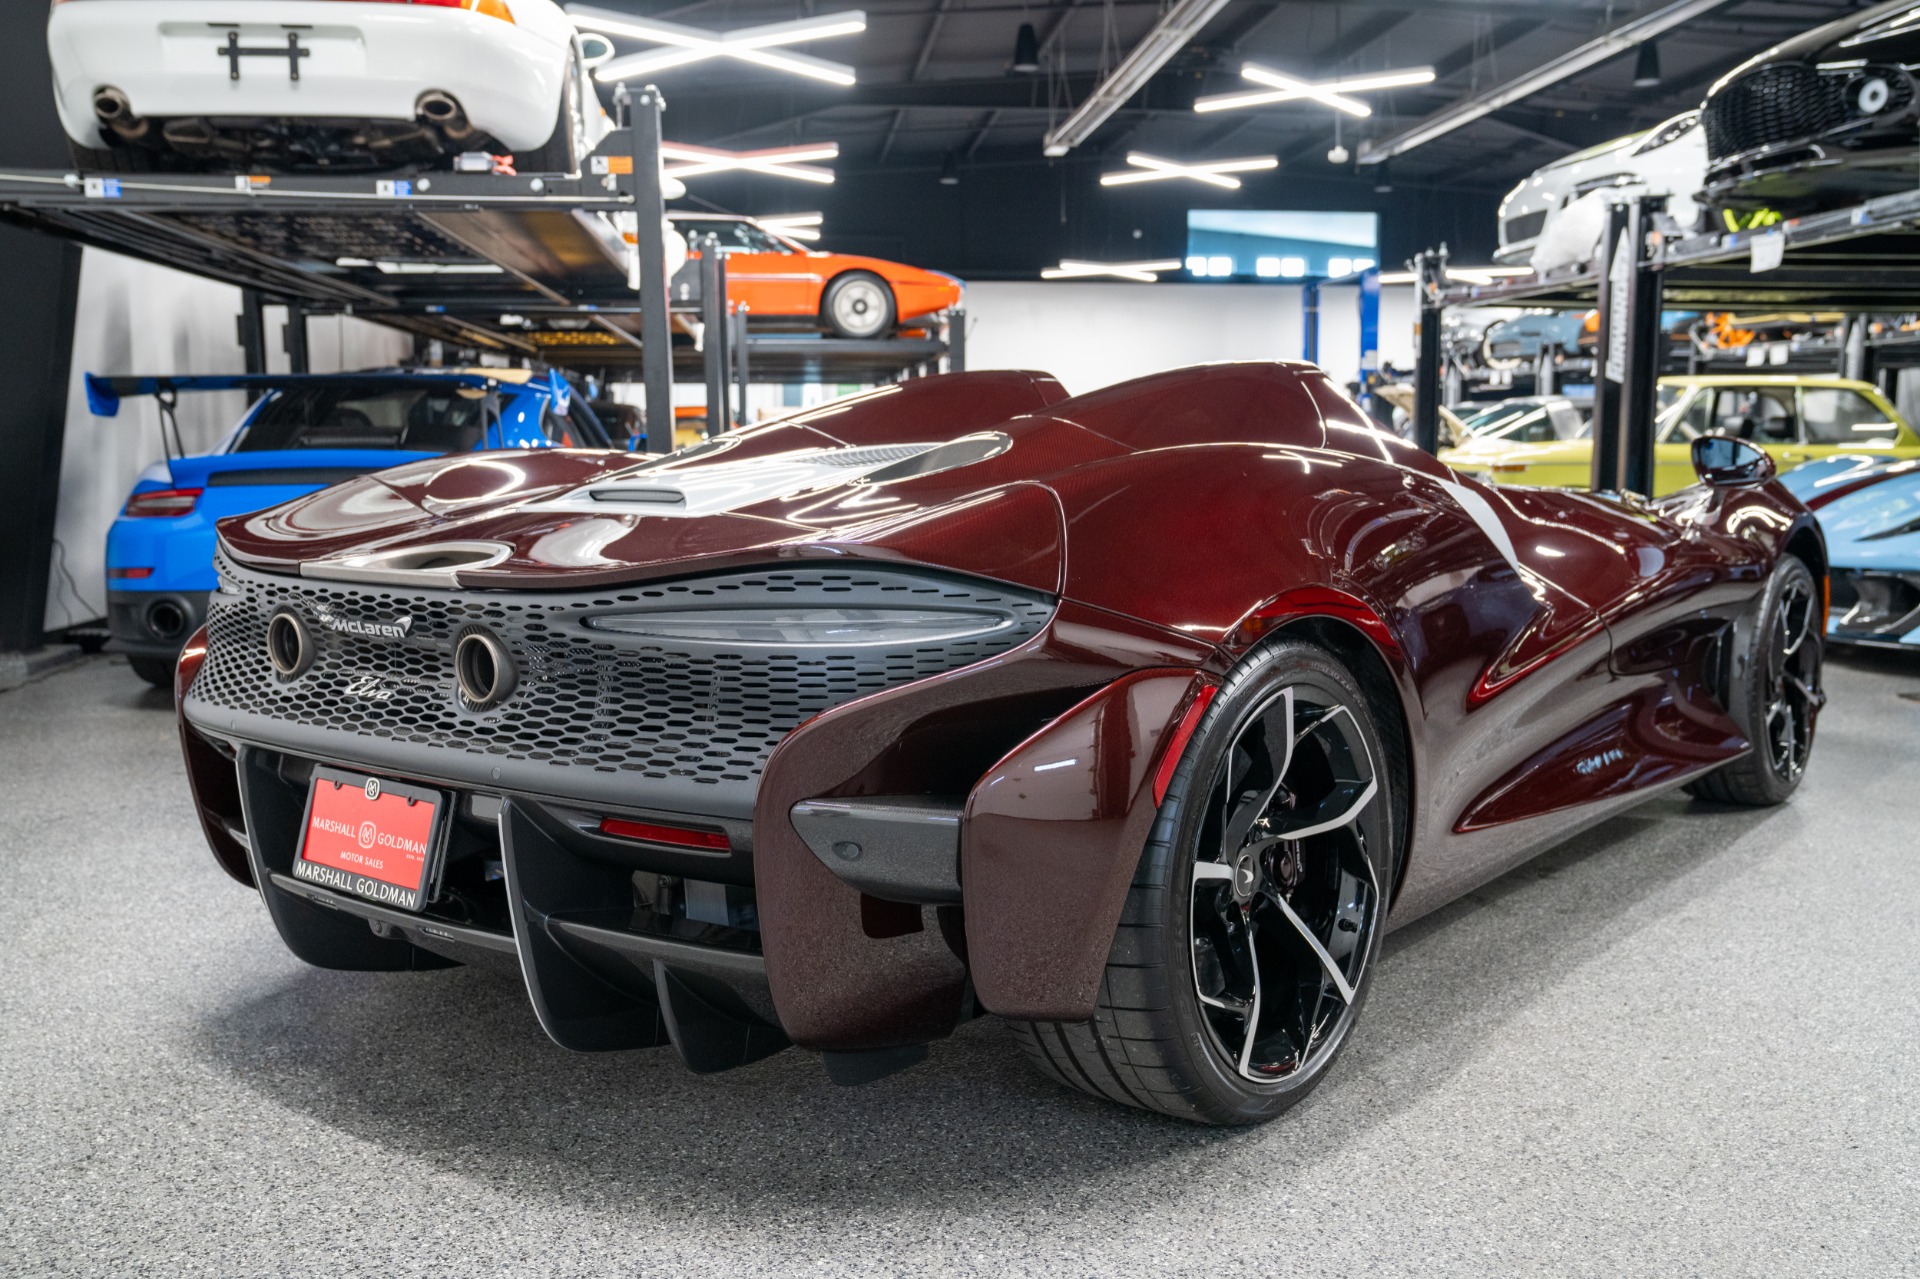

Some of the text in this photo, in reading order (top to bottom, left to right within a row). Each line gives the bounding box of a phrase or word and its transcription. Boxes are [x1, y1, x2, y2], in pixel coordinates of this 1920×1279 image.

[331, 619, 405, 638] McLaren
[344, 676, 392, 700] Elva
[312, 816, 428, 855] MARSHALL GOLDMAN
[340, 851, 384, 869] MOTOR SALES
[296, 861, 416, 908] MARSHALL GOLDMAN
